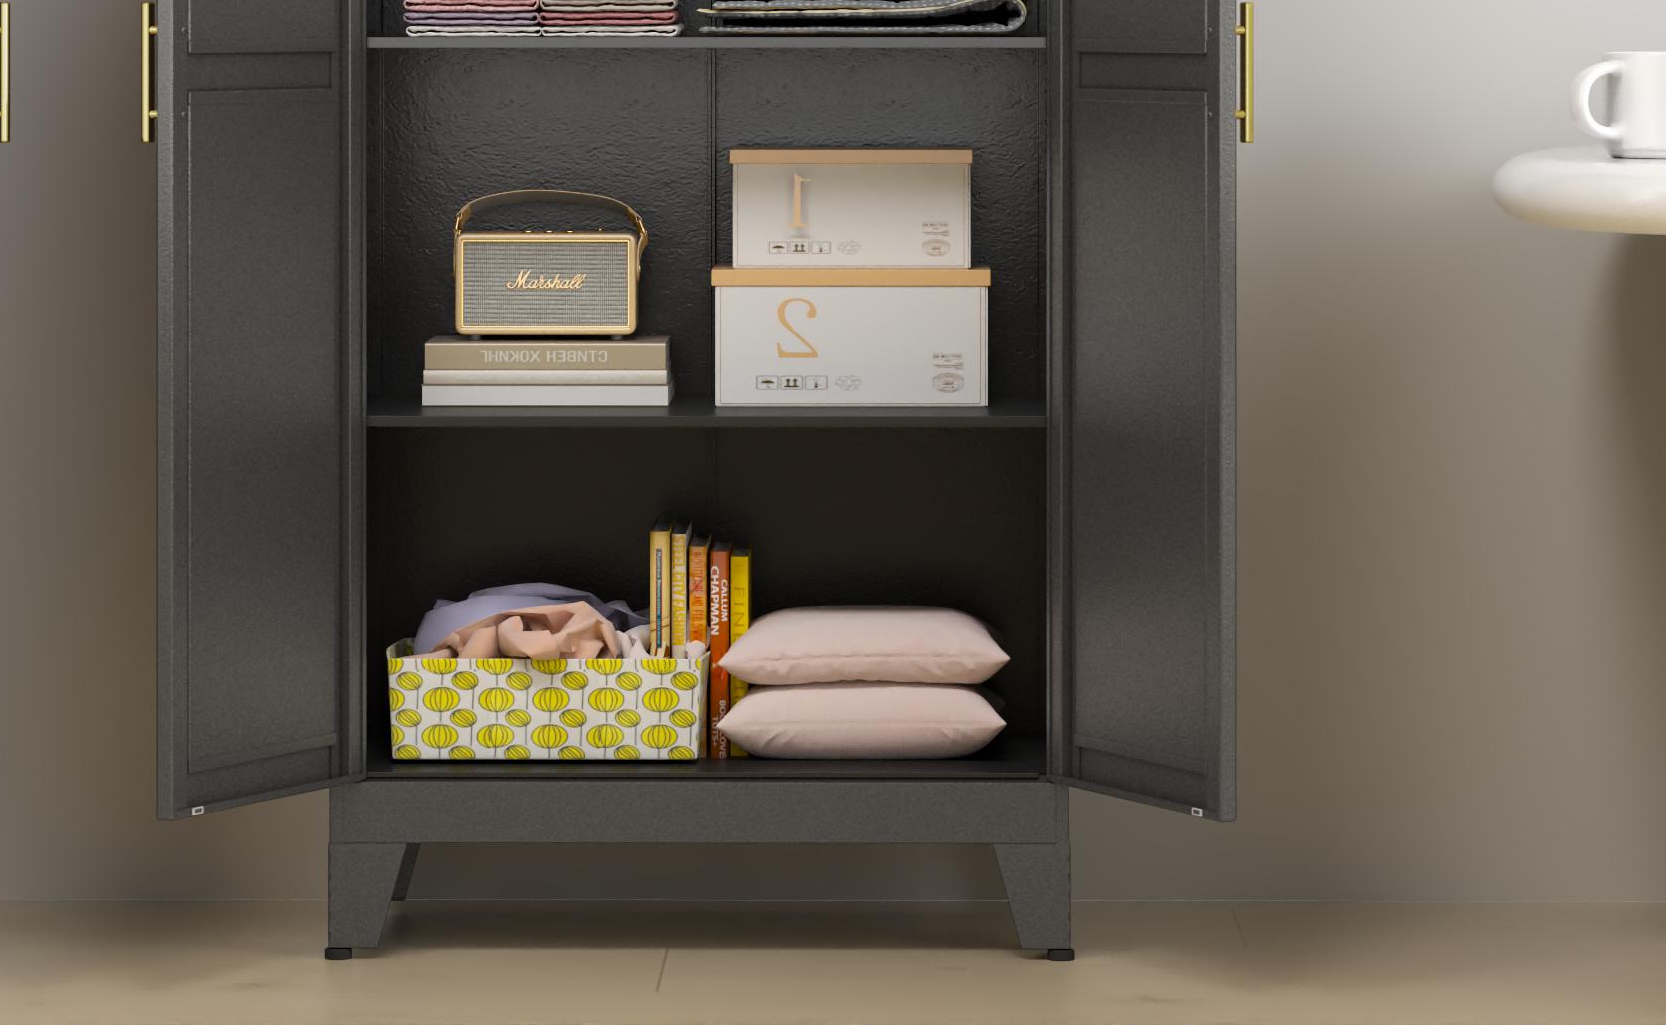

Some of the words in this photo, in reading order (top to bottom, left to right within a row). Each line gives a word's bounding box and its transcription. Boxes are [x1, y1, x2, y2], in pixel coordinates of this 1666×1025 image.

[507, 270, 587, 290] Marshall
[672, 572, 686, 596] CITY
[711, 565, 720, 635] CHAPMAN
[672, 598, 686, 646] FASHION
